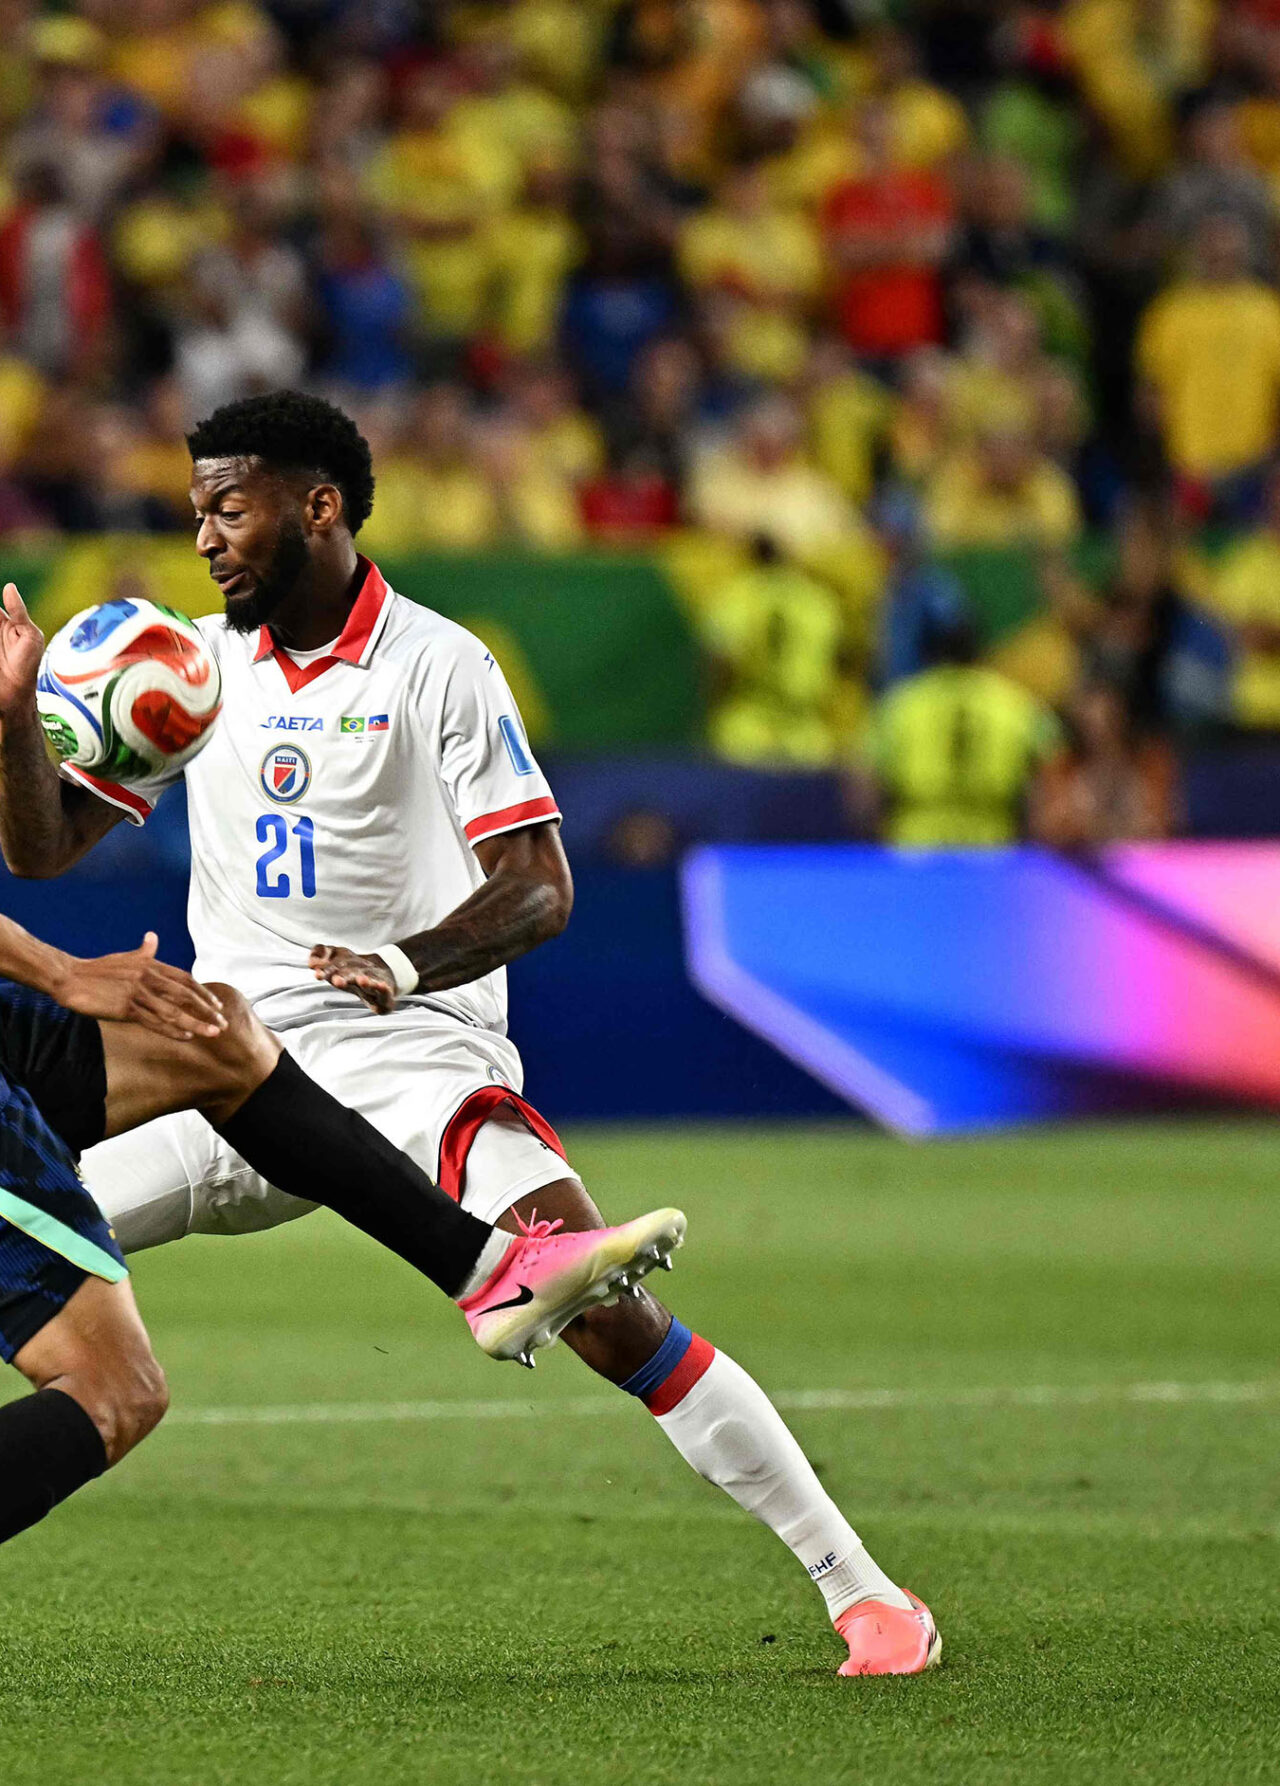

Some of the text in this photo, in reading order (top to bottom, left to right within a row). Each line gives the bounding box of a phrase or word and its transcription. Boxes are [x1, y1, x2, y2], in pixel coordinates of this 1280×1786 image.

[259, 715, 324, 731] SAETA
[255, 814, 317, 899] 21
[808, 1551, 837, 1577] FHF
